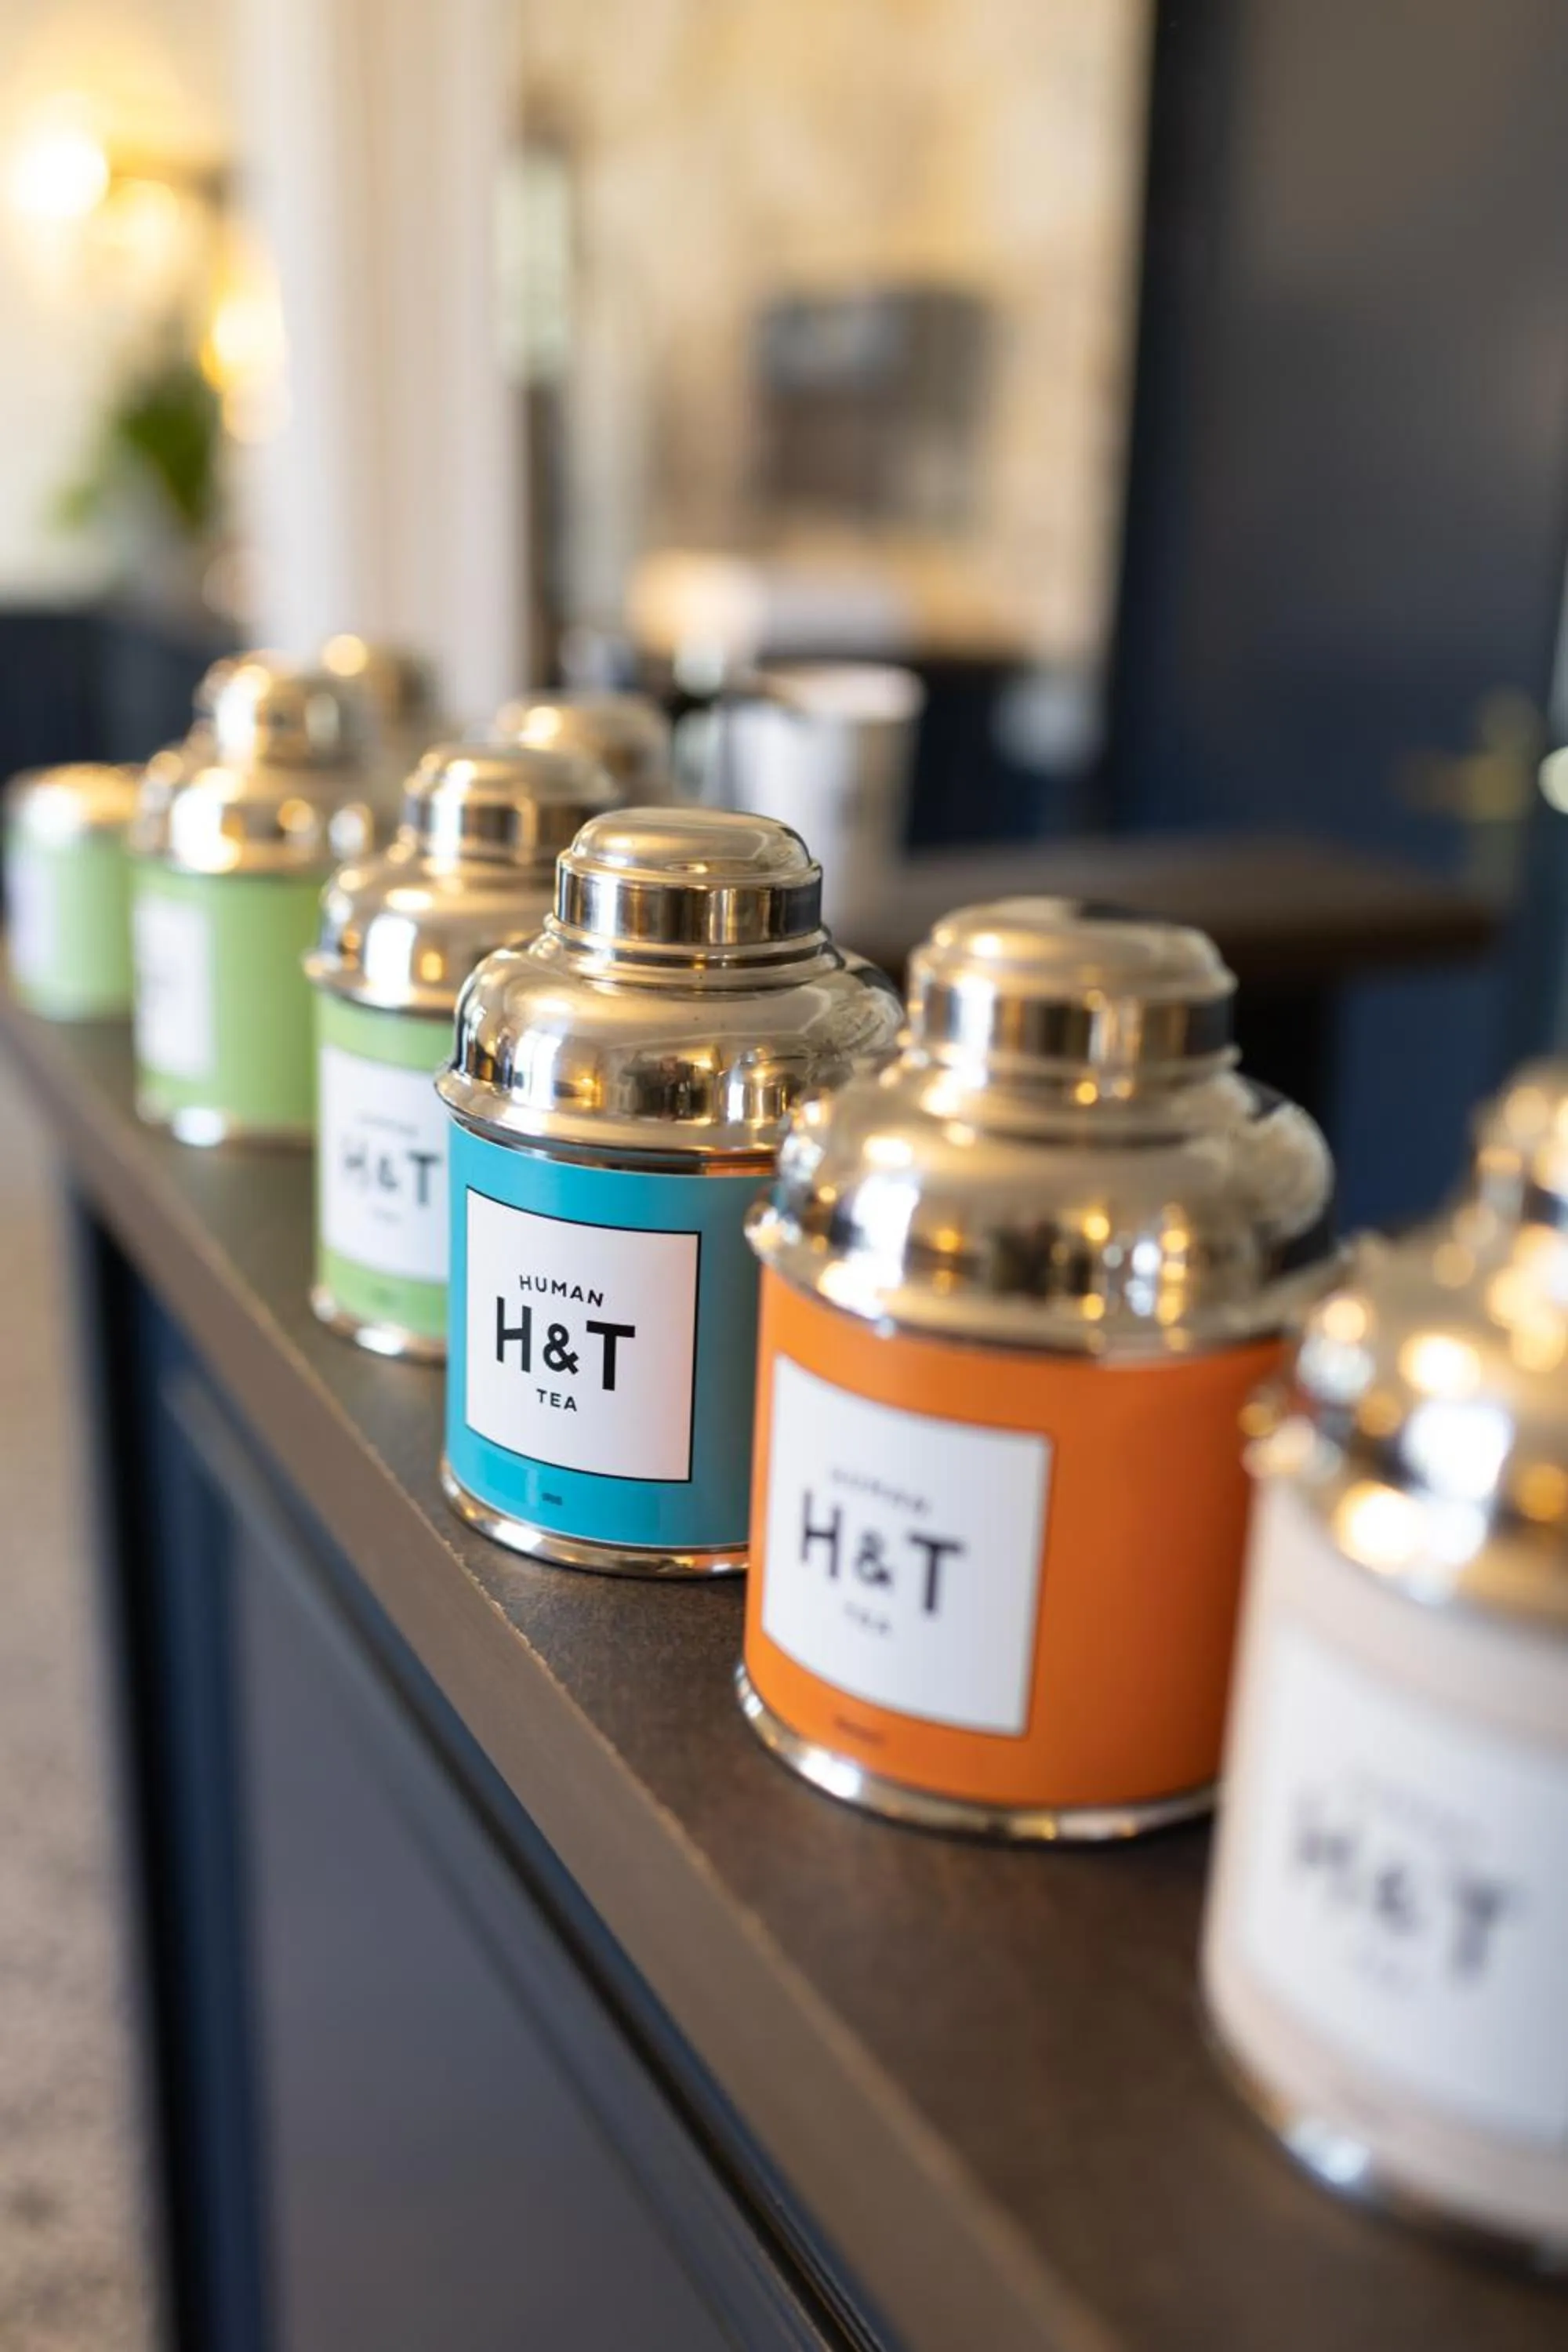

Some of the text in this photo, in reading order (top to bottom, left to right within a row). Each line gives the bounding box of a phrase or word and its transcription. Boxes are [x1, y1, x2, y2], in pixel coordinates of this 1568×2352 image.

[519, 1274, 604, 1307] HUMAN
[496, 1296, 636, 1391] H&T
[536, 1388, 577, 1412] TEA
[800, 1487, 967, 1616] H&T
